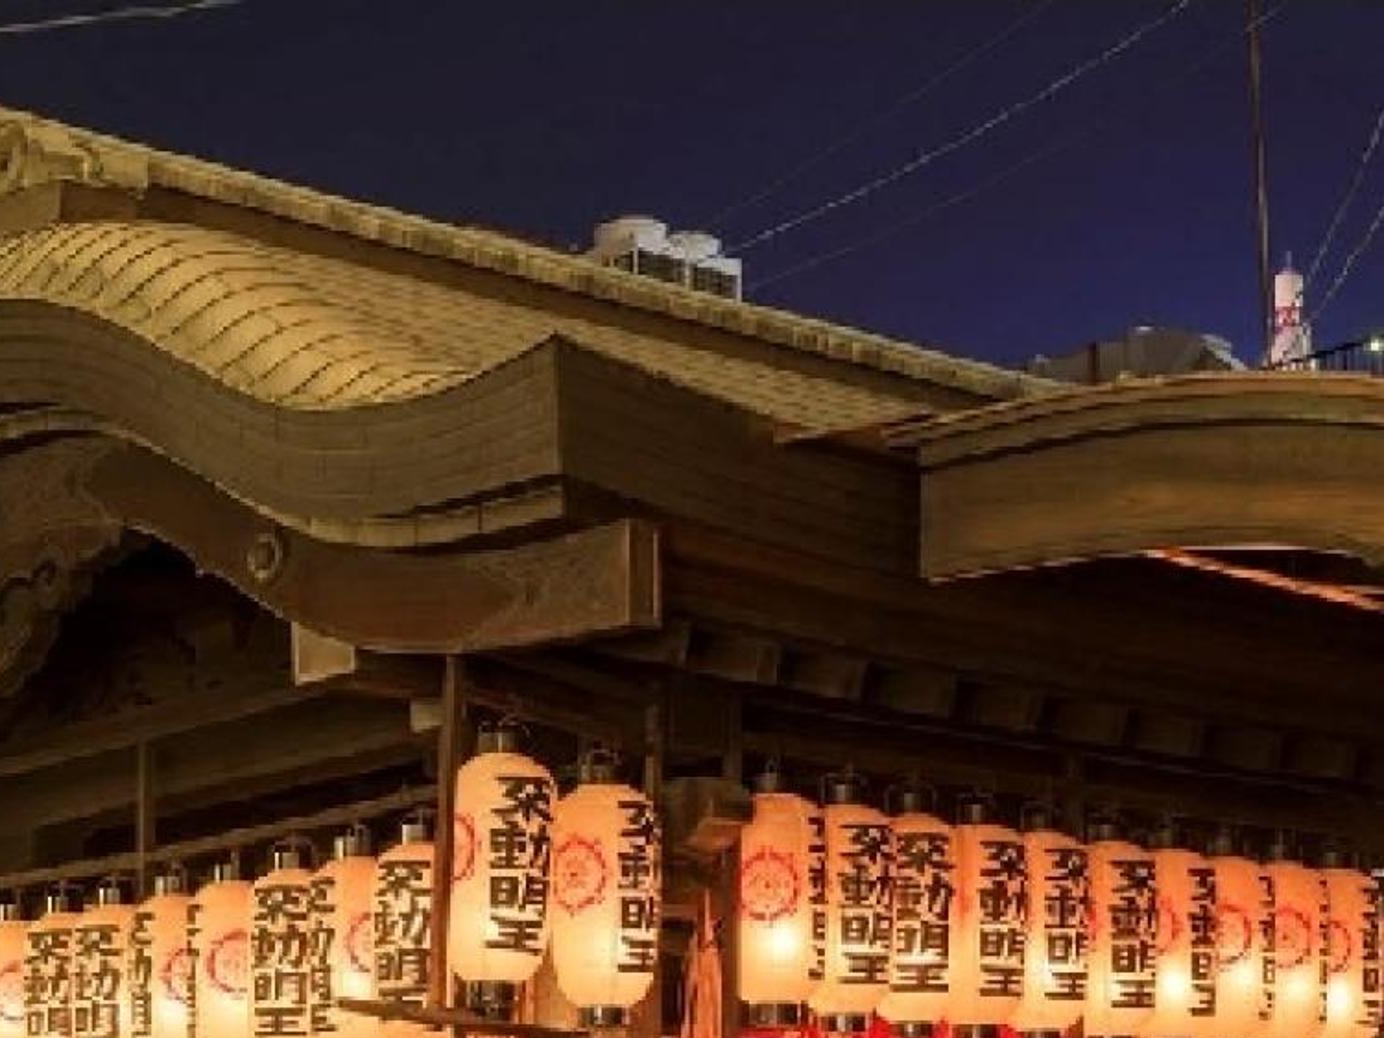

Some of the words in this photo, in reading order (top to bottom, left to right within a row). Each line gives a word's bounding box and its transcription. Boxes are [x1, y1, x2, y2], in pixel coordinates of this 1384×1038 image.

[484, 776, 553, 957] 不動明王
[252, 883, 310, 1036] 不動明王
